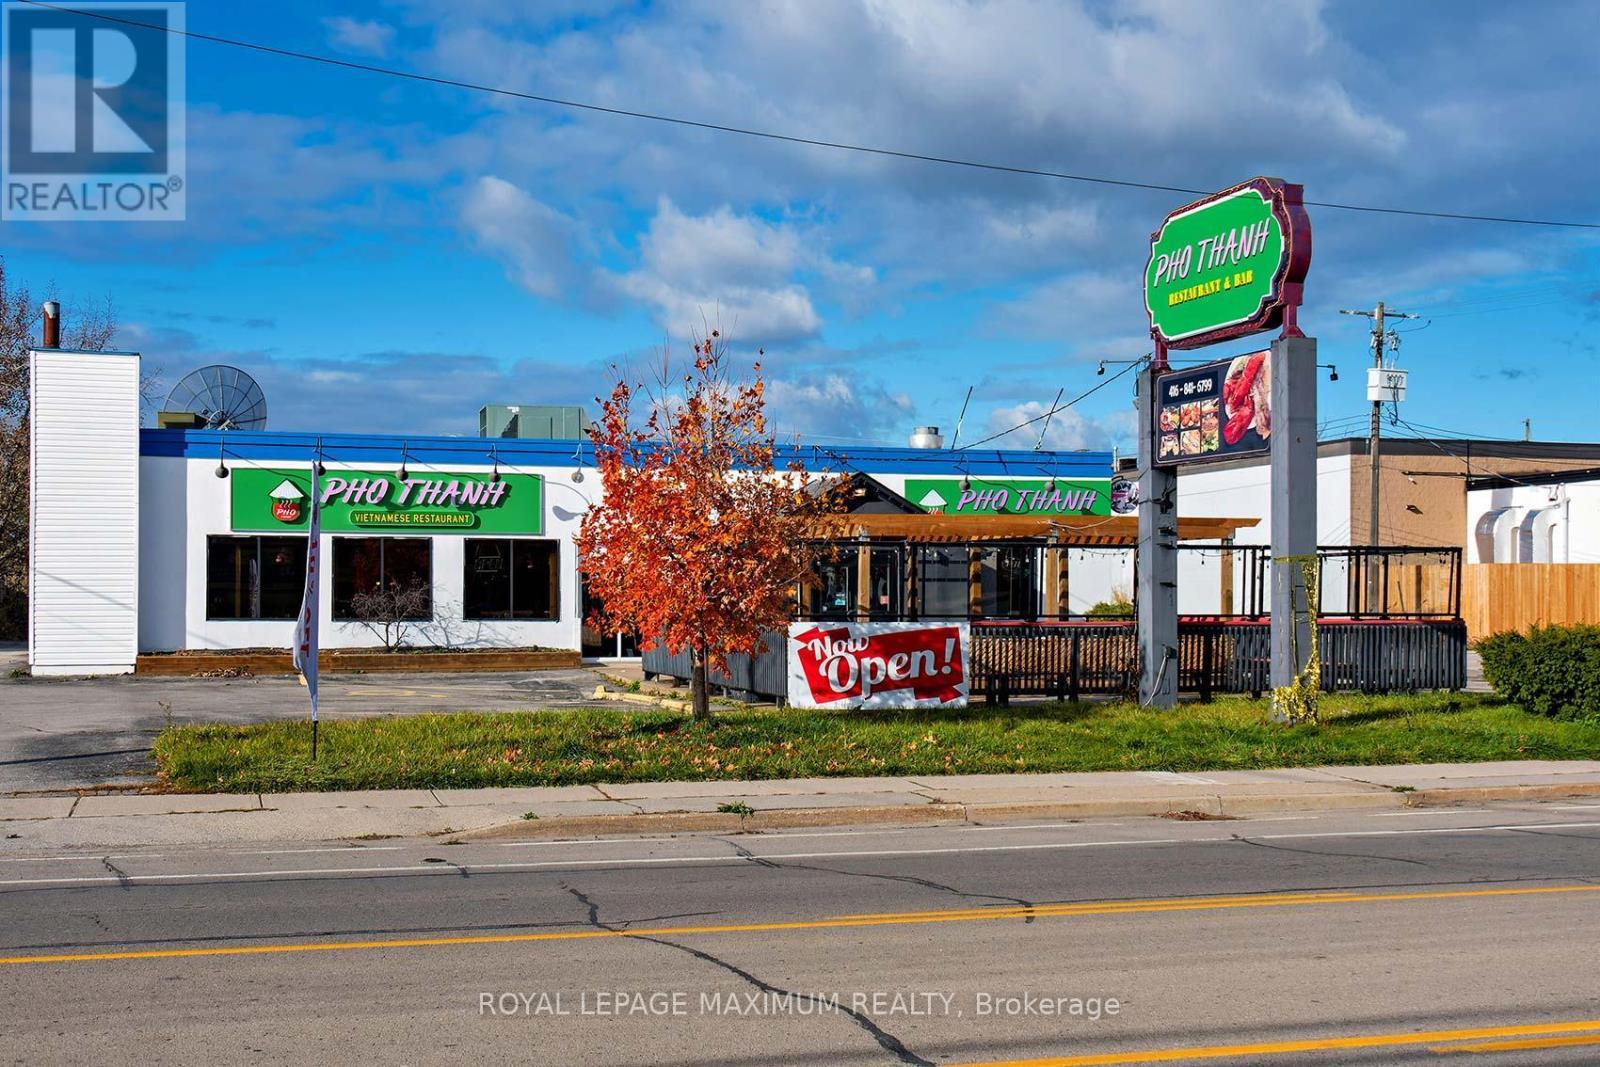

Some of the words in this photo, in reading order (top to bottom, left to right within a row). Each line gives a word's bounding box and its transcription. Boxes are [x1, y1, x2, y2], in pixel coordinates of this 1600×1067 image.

[1153, 244, 1192, 288] PHO
[1197, 217, 1270, 273] THANH
[1168, 278, 1221, 307] RESTAURANT
[1223, 276, 1231, 291] &
[1234, 270, 1253, 287] BAR
[320, 477, 389, 504] PHO
[398, 478, 506, 508] THANH
[956, 489, 1009, 511] PHO
[1015, 489, 1097, 512] THANH
[354, 513, 411, 523] VIETNAMESE
[413, 514, 470, 523] RESTAURANT
[808, 635, 870, 661] Now
